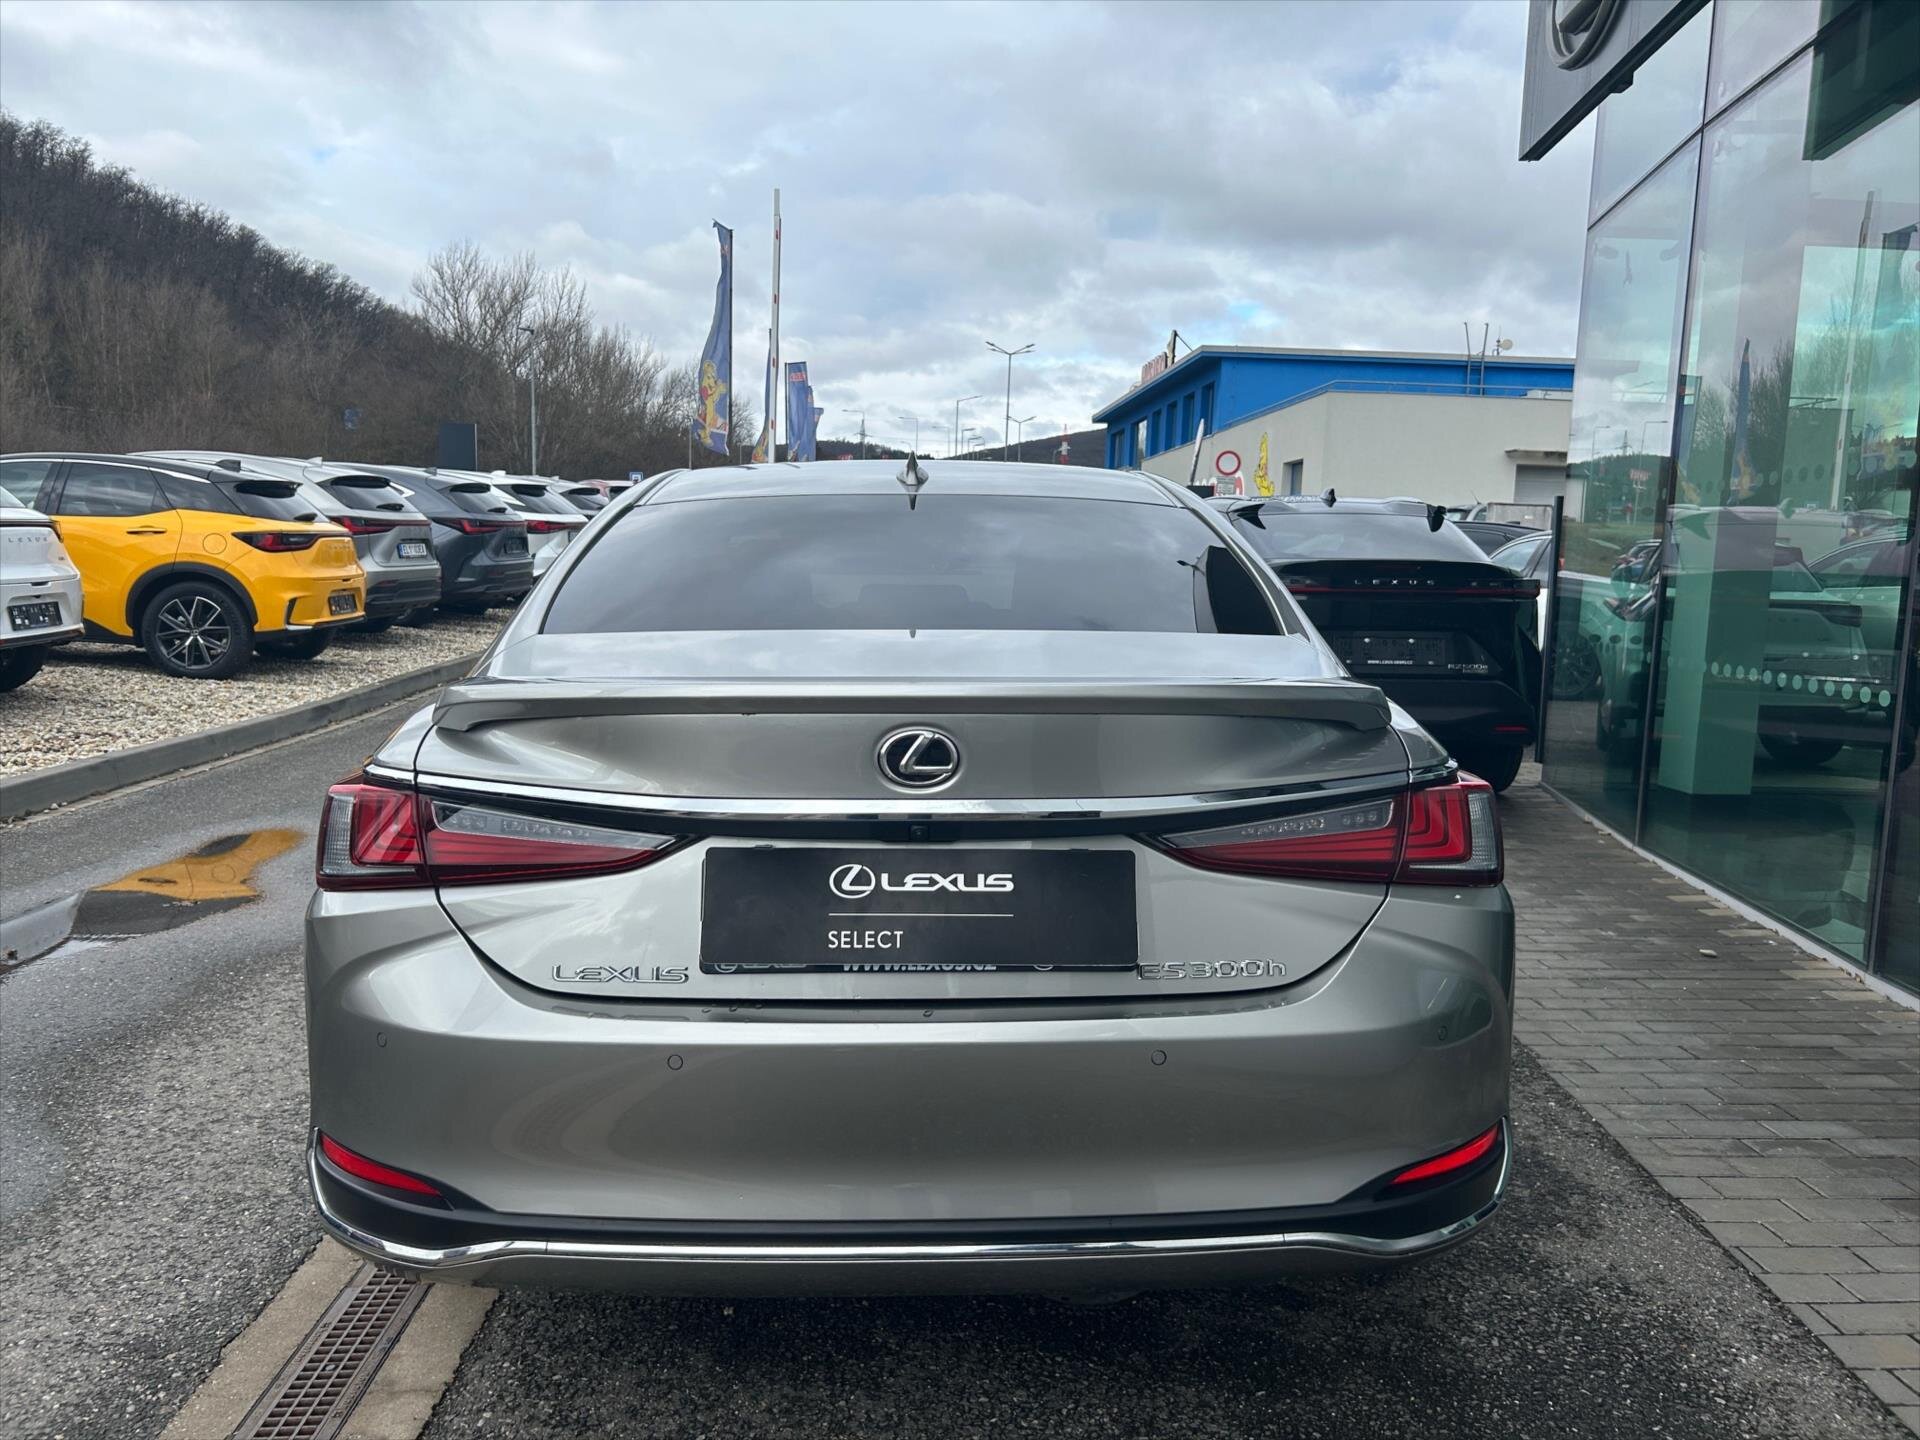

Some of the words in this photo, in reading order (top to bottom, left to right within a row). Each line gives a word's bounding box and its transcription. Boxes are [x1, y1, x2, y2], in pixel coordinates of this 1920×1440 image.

[881, 873, 1015, 892] LEXUS
[828, 930, 904, 949] SELECT
[552, 965, 689, 983] LEXUS
[1137, 959, 1287, 980] ES300h
